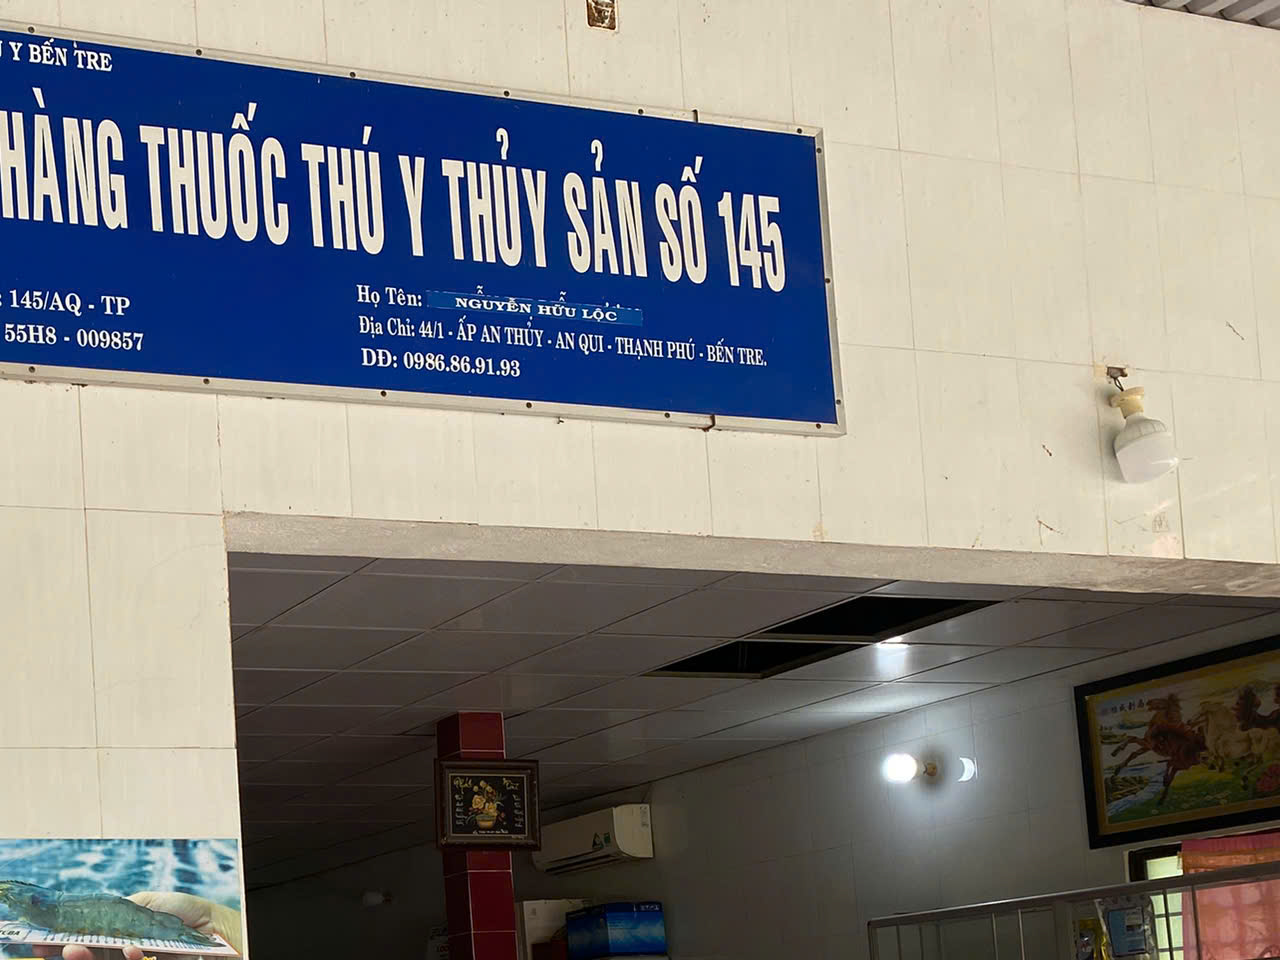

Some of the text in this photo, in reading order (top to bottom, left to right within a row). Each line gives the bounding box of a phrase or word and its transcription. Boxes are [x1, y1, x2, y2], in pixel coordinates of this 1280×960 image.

[9, 42, 22, 61] Y
[29, 38, 67, 66] BẾN
[74, 50, 112, 71] TRE
[139, 102, 289, 245] THUỐC
[302, 126, 385, 256] THÚ
[399, 155, 425, 257] Y
[441, 128, 547, 268] THỦY
[563, 140, 647, 278] SẢN
[655, 156, 707, 284] SỐ
[718, 191, 785, 293] 145
[10, 290, 82, 316] 145/AQ
[101, 295, 130, 315] TP
[356, 284, 422, 308] Họ Tên:
[455, 285, 617, 322] NGUYỄN HỮU LỘC
[5, 324, 57, 344] 55H8
[77, 329, 144, 350] 009857
[359, 315, 767, 367] Địa Chỉ: 44/1 ẤP AN THỦY AN QUI THẠNH PHÚ BẾN TRE.
[361, 348, 521, 377] DĐ: 0986.86.91.93
